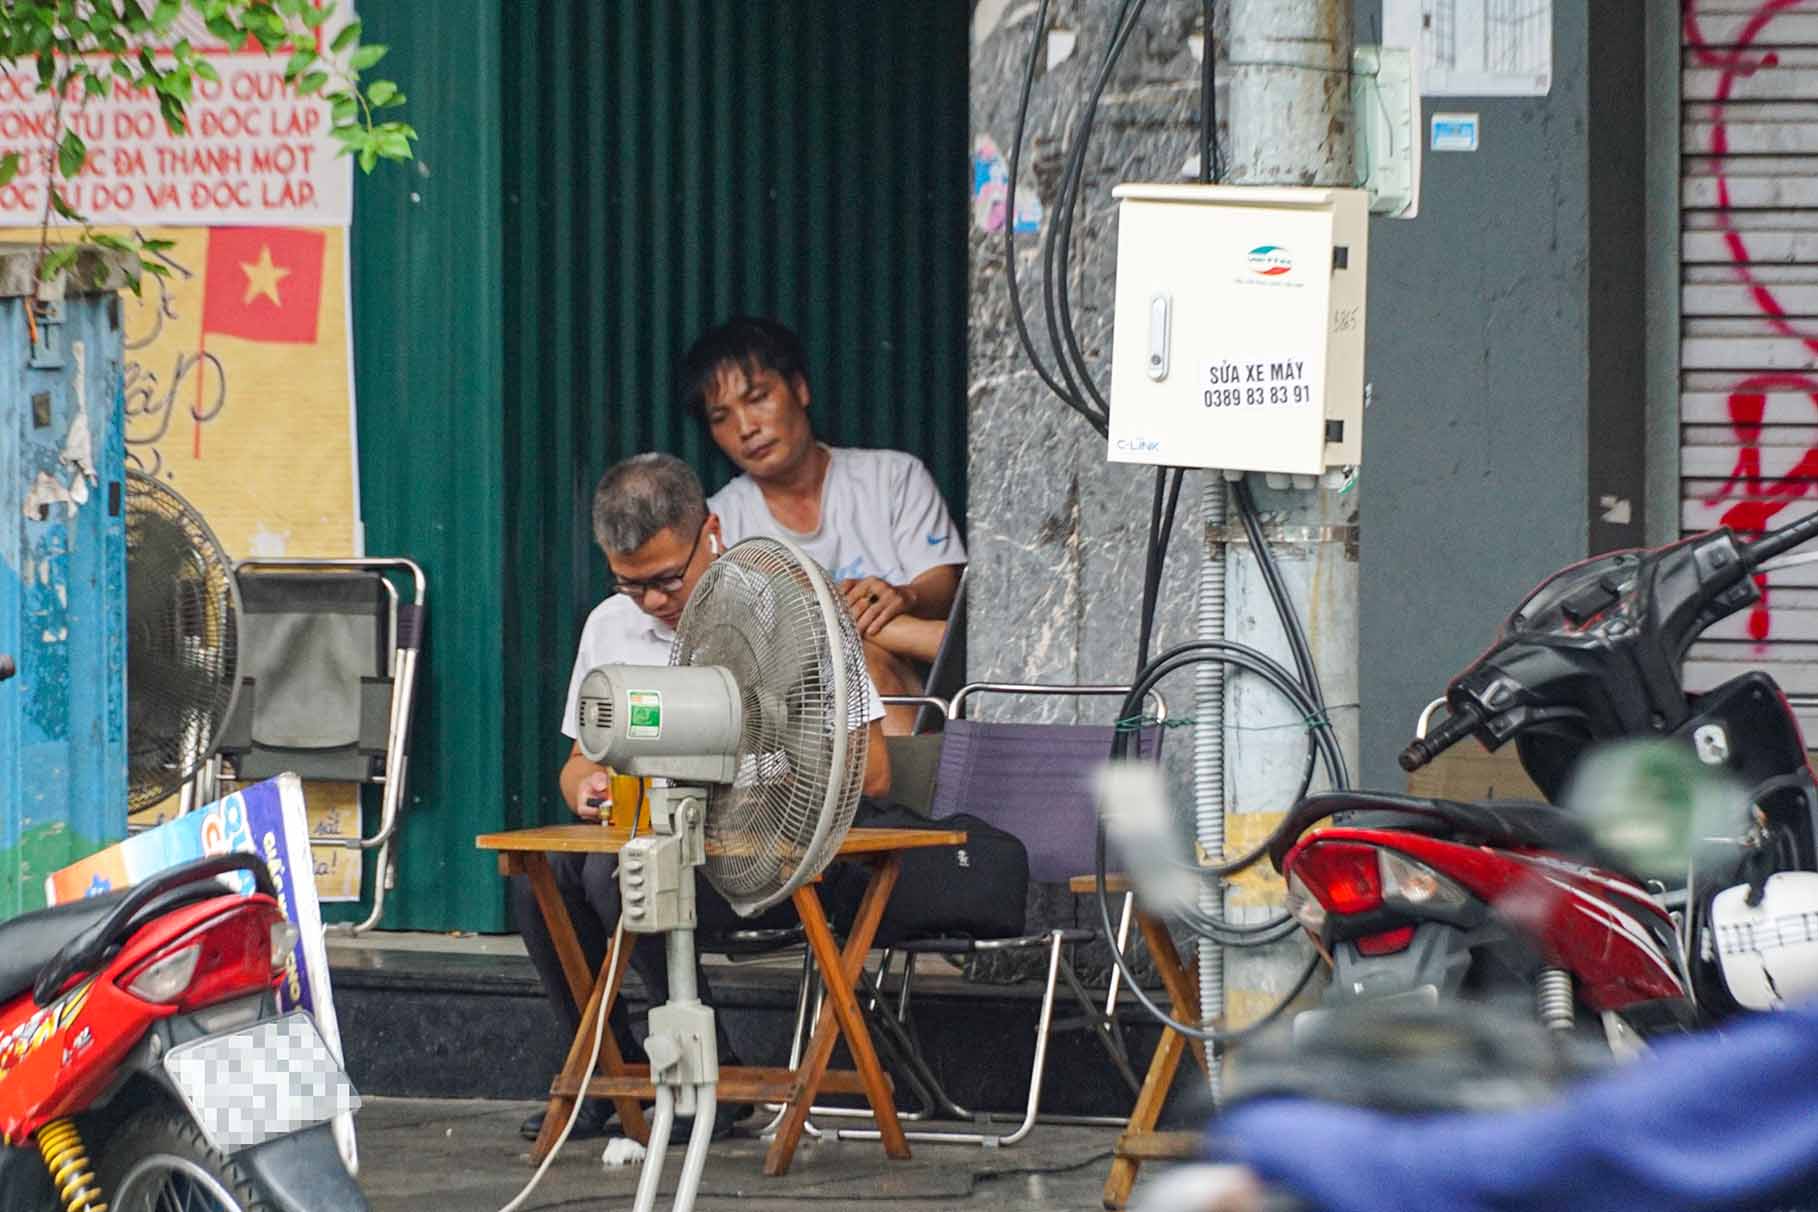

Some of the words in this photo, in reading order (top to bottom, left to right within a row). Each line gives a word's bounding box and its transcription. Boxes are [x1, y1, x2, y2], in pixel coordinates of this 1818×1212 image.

[1246, 364, 1265, 382] XE
[1270, 358, 1304, 382] MÁY
[1204, 388, 1240, 407] 0389
[1246, 386, 1265, 405] 83
[1270, 385, 1288, 404] 83
[1293, 384, 1310, 403] 91
